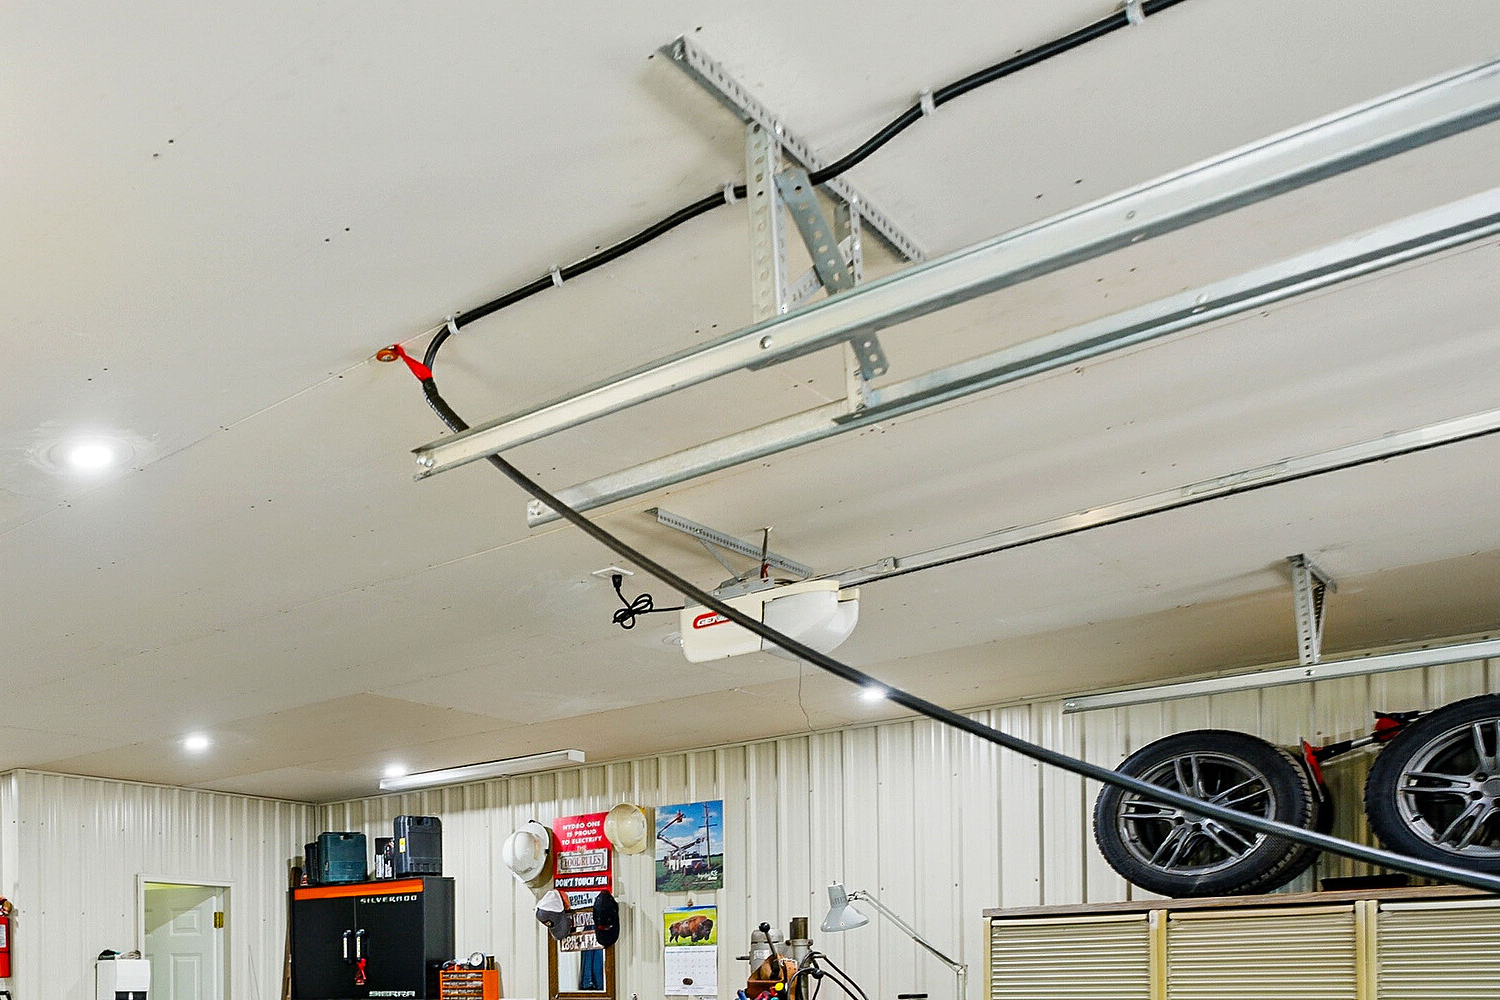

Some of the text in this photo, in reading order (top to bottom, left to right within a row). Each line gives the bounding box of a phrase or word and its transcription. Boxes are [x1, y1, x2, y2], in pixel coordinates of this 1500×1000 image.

[555, 878, 573, 887] DON'T
[575, 876, 594, 886] TOUCH
[360, 895, 418, 904] SILVERADO
